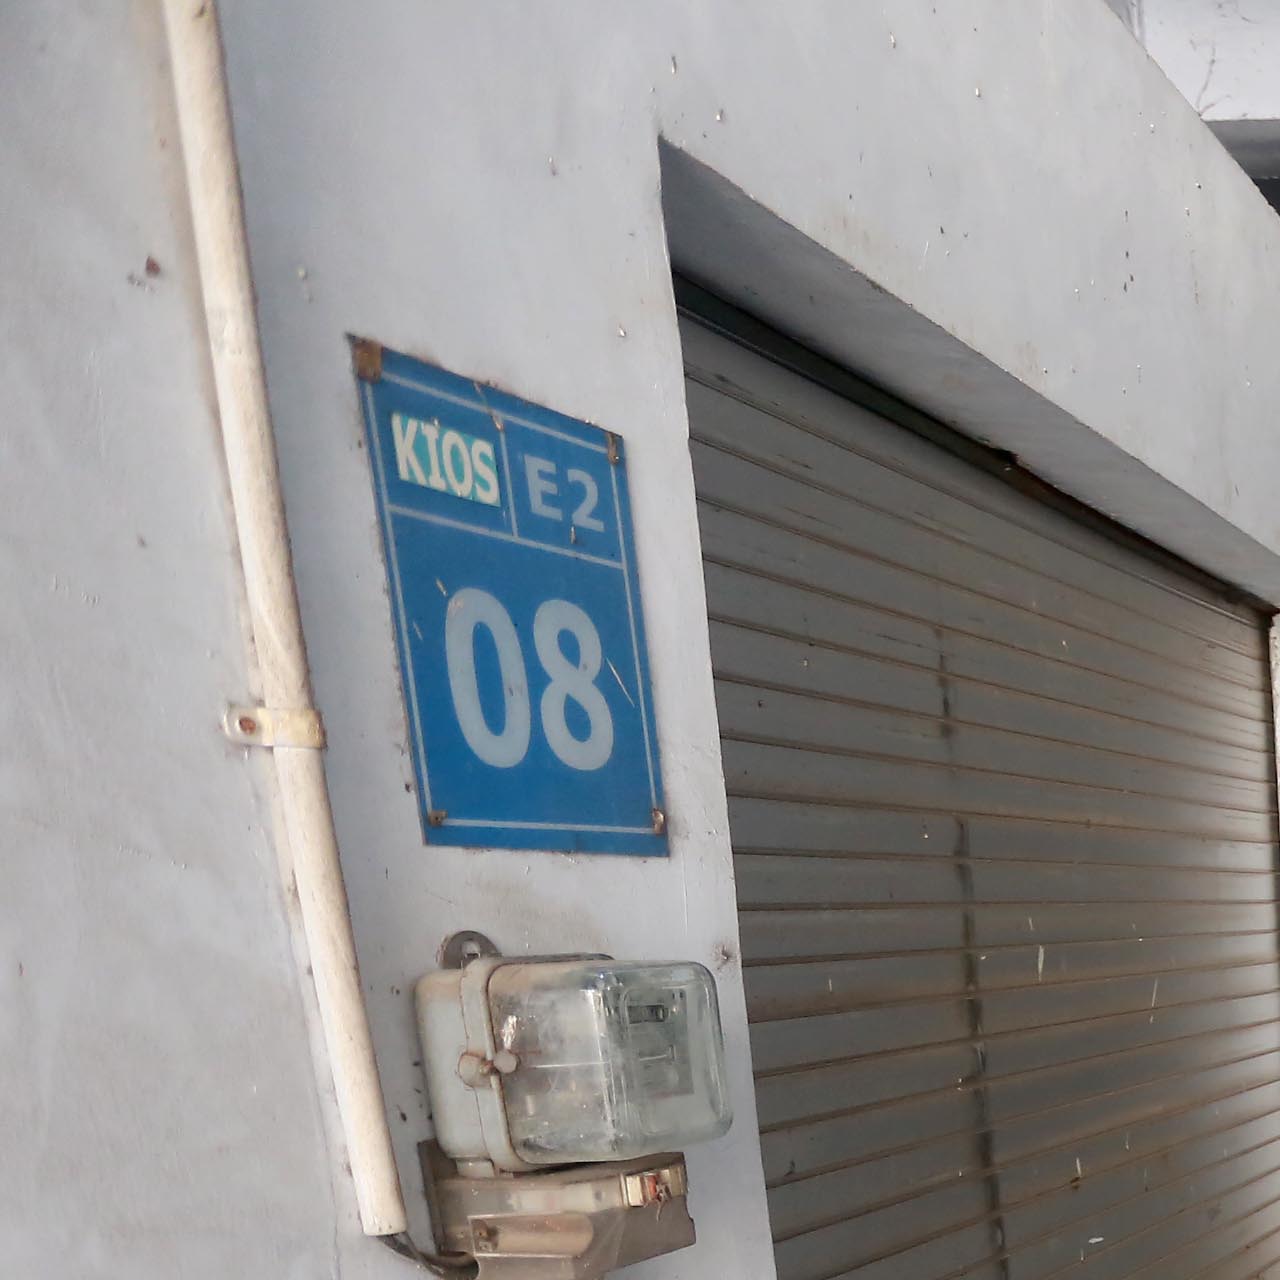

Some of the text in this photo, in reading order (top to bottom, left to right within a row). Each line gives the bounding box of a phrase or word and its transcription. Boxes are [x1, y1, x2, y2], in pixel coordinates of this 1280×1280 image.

[391, 414, 605, 533] KIOS E2
[445, 588, 614, 771] 08
